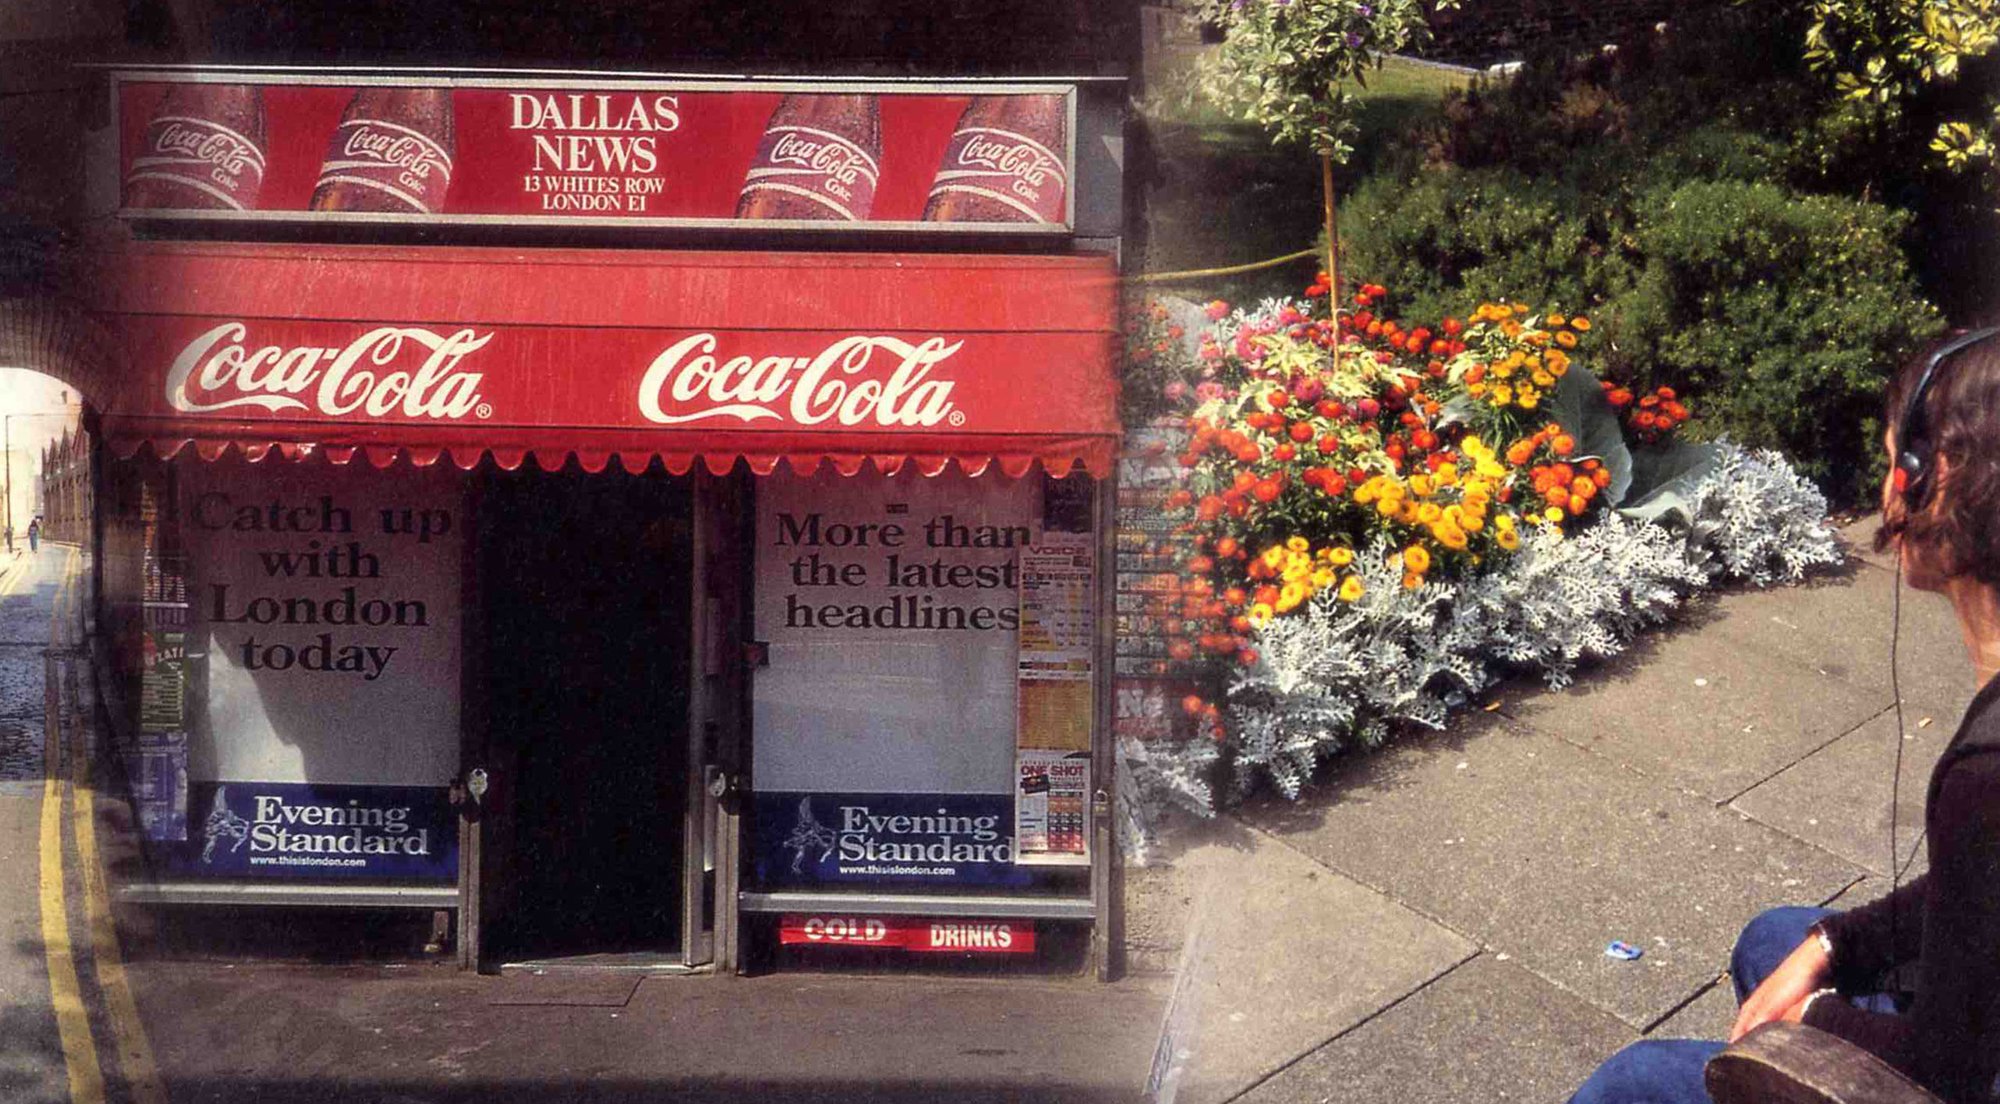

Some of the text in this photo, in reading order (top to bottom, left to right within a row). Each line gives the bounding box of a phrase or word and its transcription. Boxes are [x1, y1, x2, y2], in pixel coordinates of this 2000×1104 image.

[510, 94, 679, 131] DALLAS
[156, 123, 250, 175] Coca-Cola
[344, 126, 437, 178] Coca-Cola
[532, 135, 657, 173] NEWS
[769, 132, 865, 185] Coca-Cola
[958, 134, 1052, 186] Coca-Cola
[211, 167, 239, 192] Coke
[399, 171, 427, 196] Coke
[524, 176, 665, 193] 13 WHITES ROW
[824, 177, 852, 202] Coke
[1012, 178, 1040, 203] Coke
[543, 194, 621, 210] LONDON
[192, 491, 451, 543] Catch up
[774, 512, 1031, 548] More than
[259, 540, 382, 578] with
[789, 554, 1019, 589] the latest
[208, 583, 429, 626] London
[785, 594, 1019, 630] headlines
[241, 632, 398, 680] today
[1051, 766, 1085, 776] SHOT
[253, 795, 410, 833] Evening
[839, 806, 999, 841] Evening
[250, 824, 431, 855] Standard
[839, 834, 1015, 863] Standard
[250, 856, 367, 867] www.thisislondon.com
[839, 865, 956, 876] www.thisislondon.com
[804, 918, 1012, 948] COLD DRINKS
